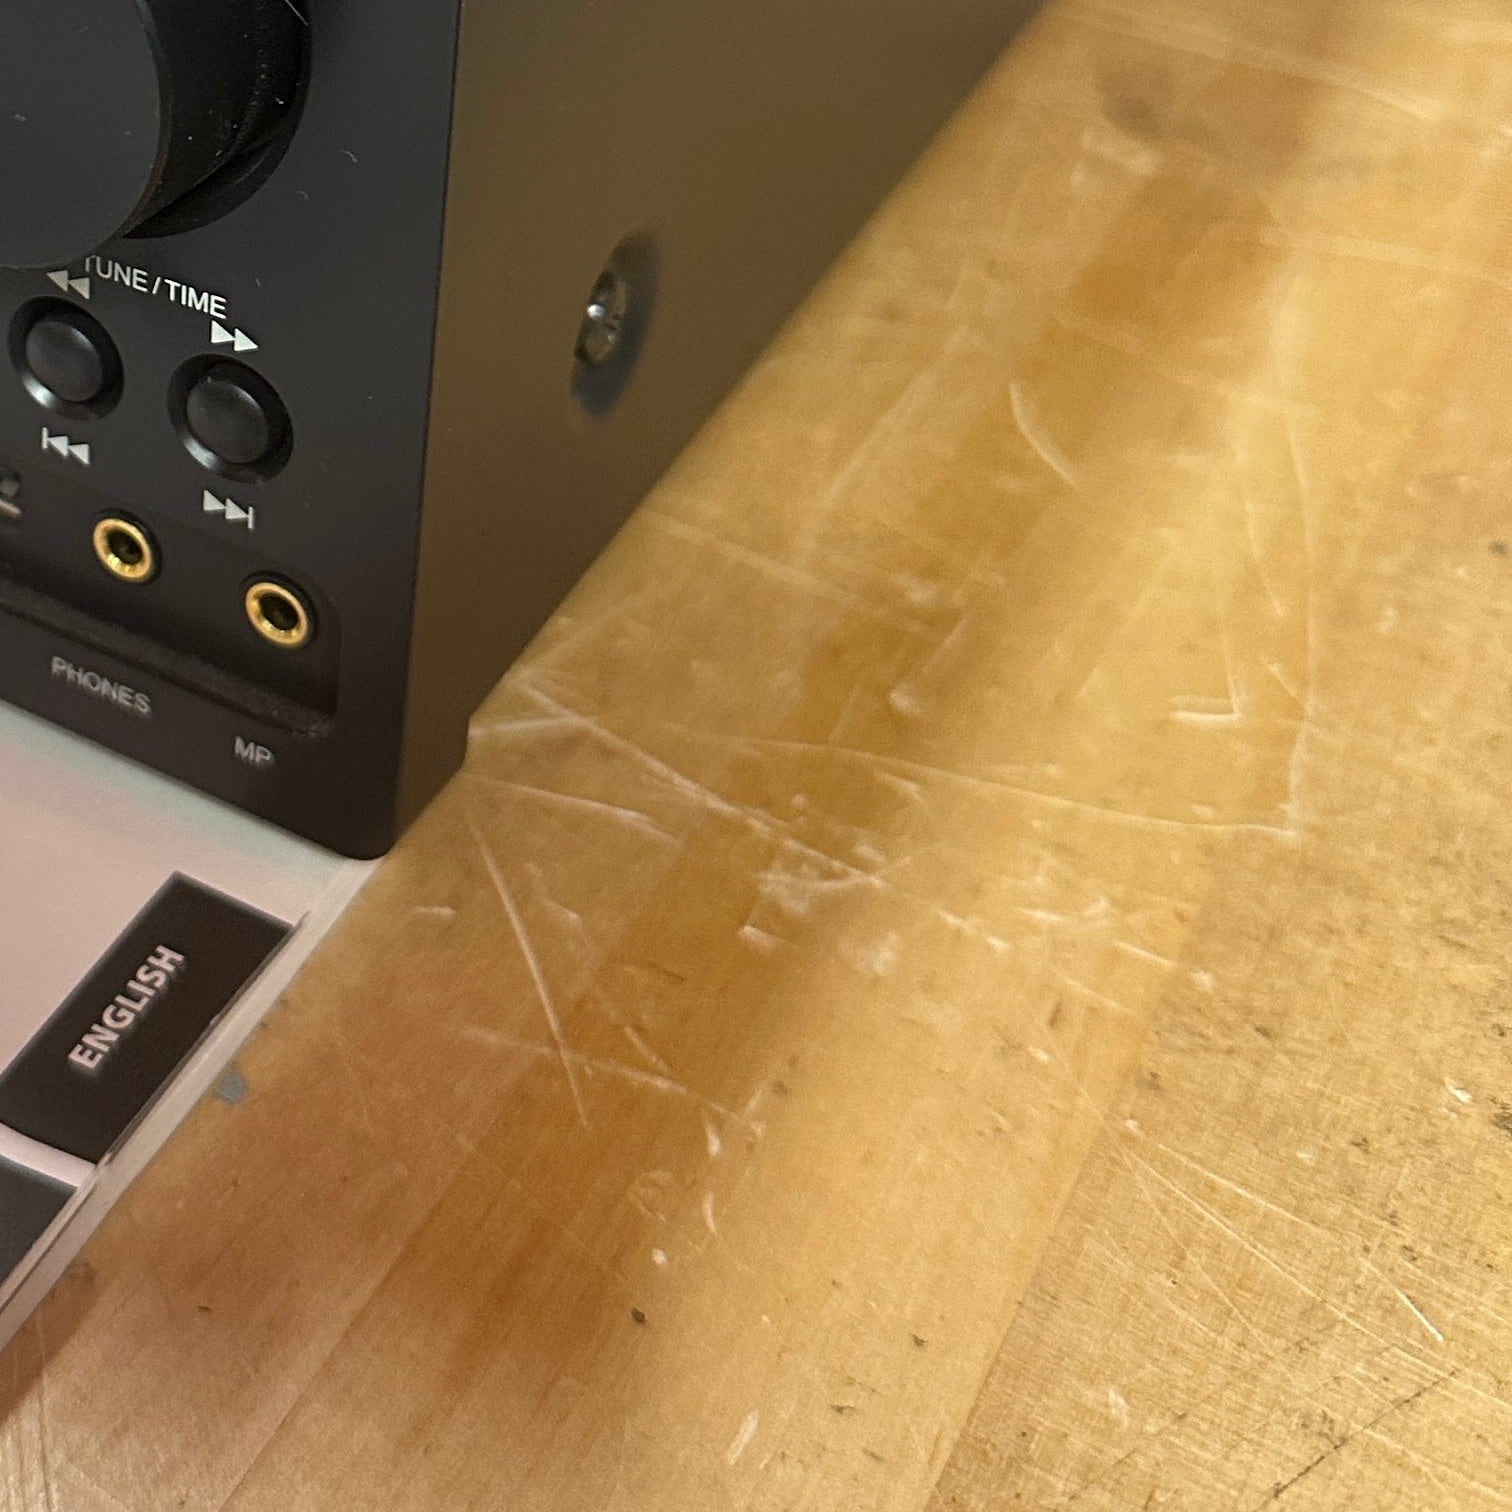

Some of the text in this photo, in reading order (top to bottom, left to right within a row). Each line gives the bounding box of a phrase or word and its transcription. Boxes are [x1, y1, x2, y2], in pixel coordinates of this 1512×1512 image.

[51, 655, 153, 719] PHONES
[234, 735, 275, 766] MP
[68, 944, 185, 1070] ENGLISH
